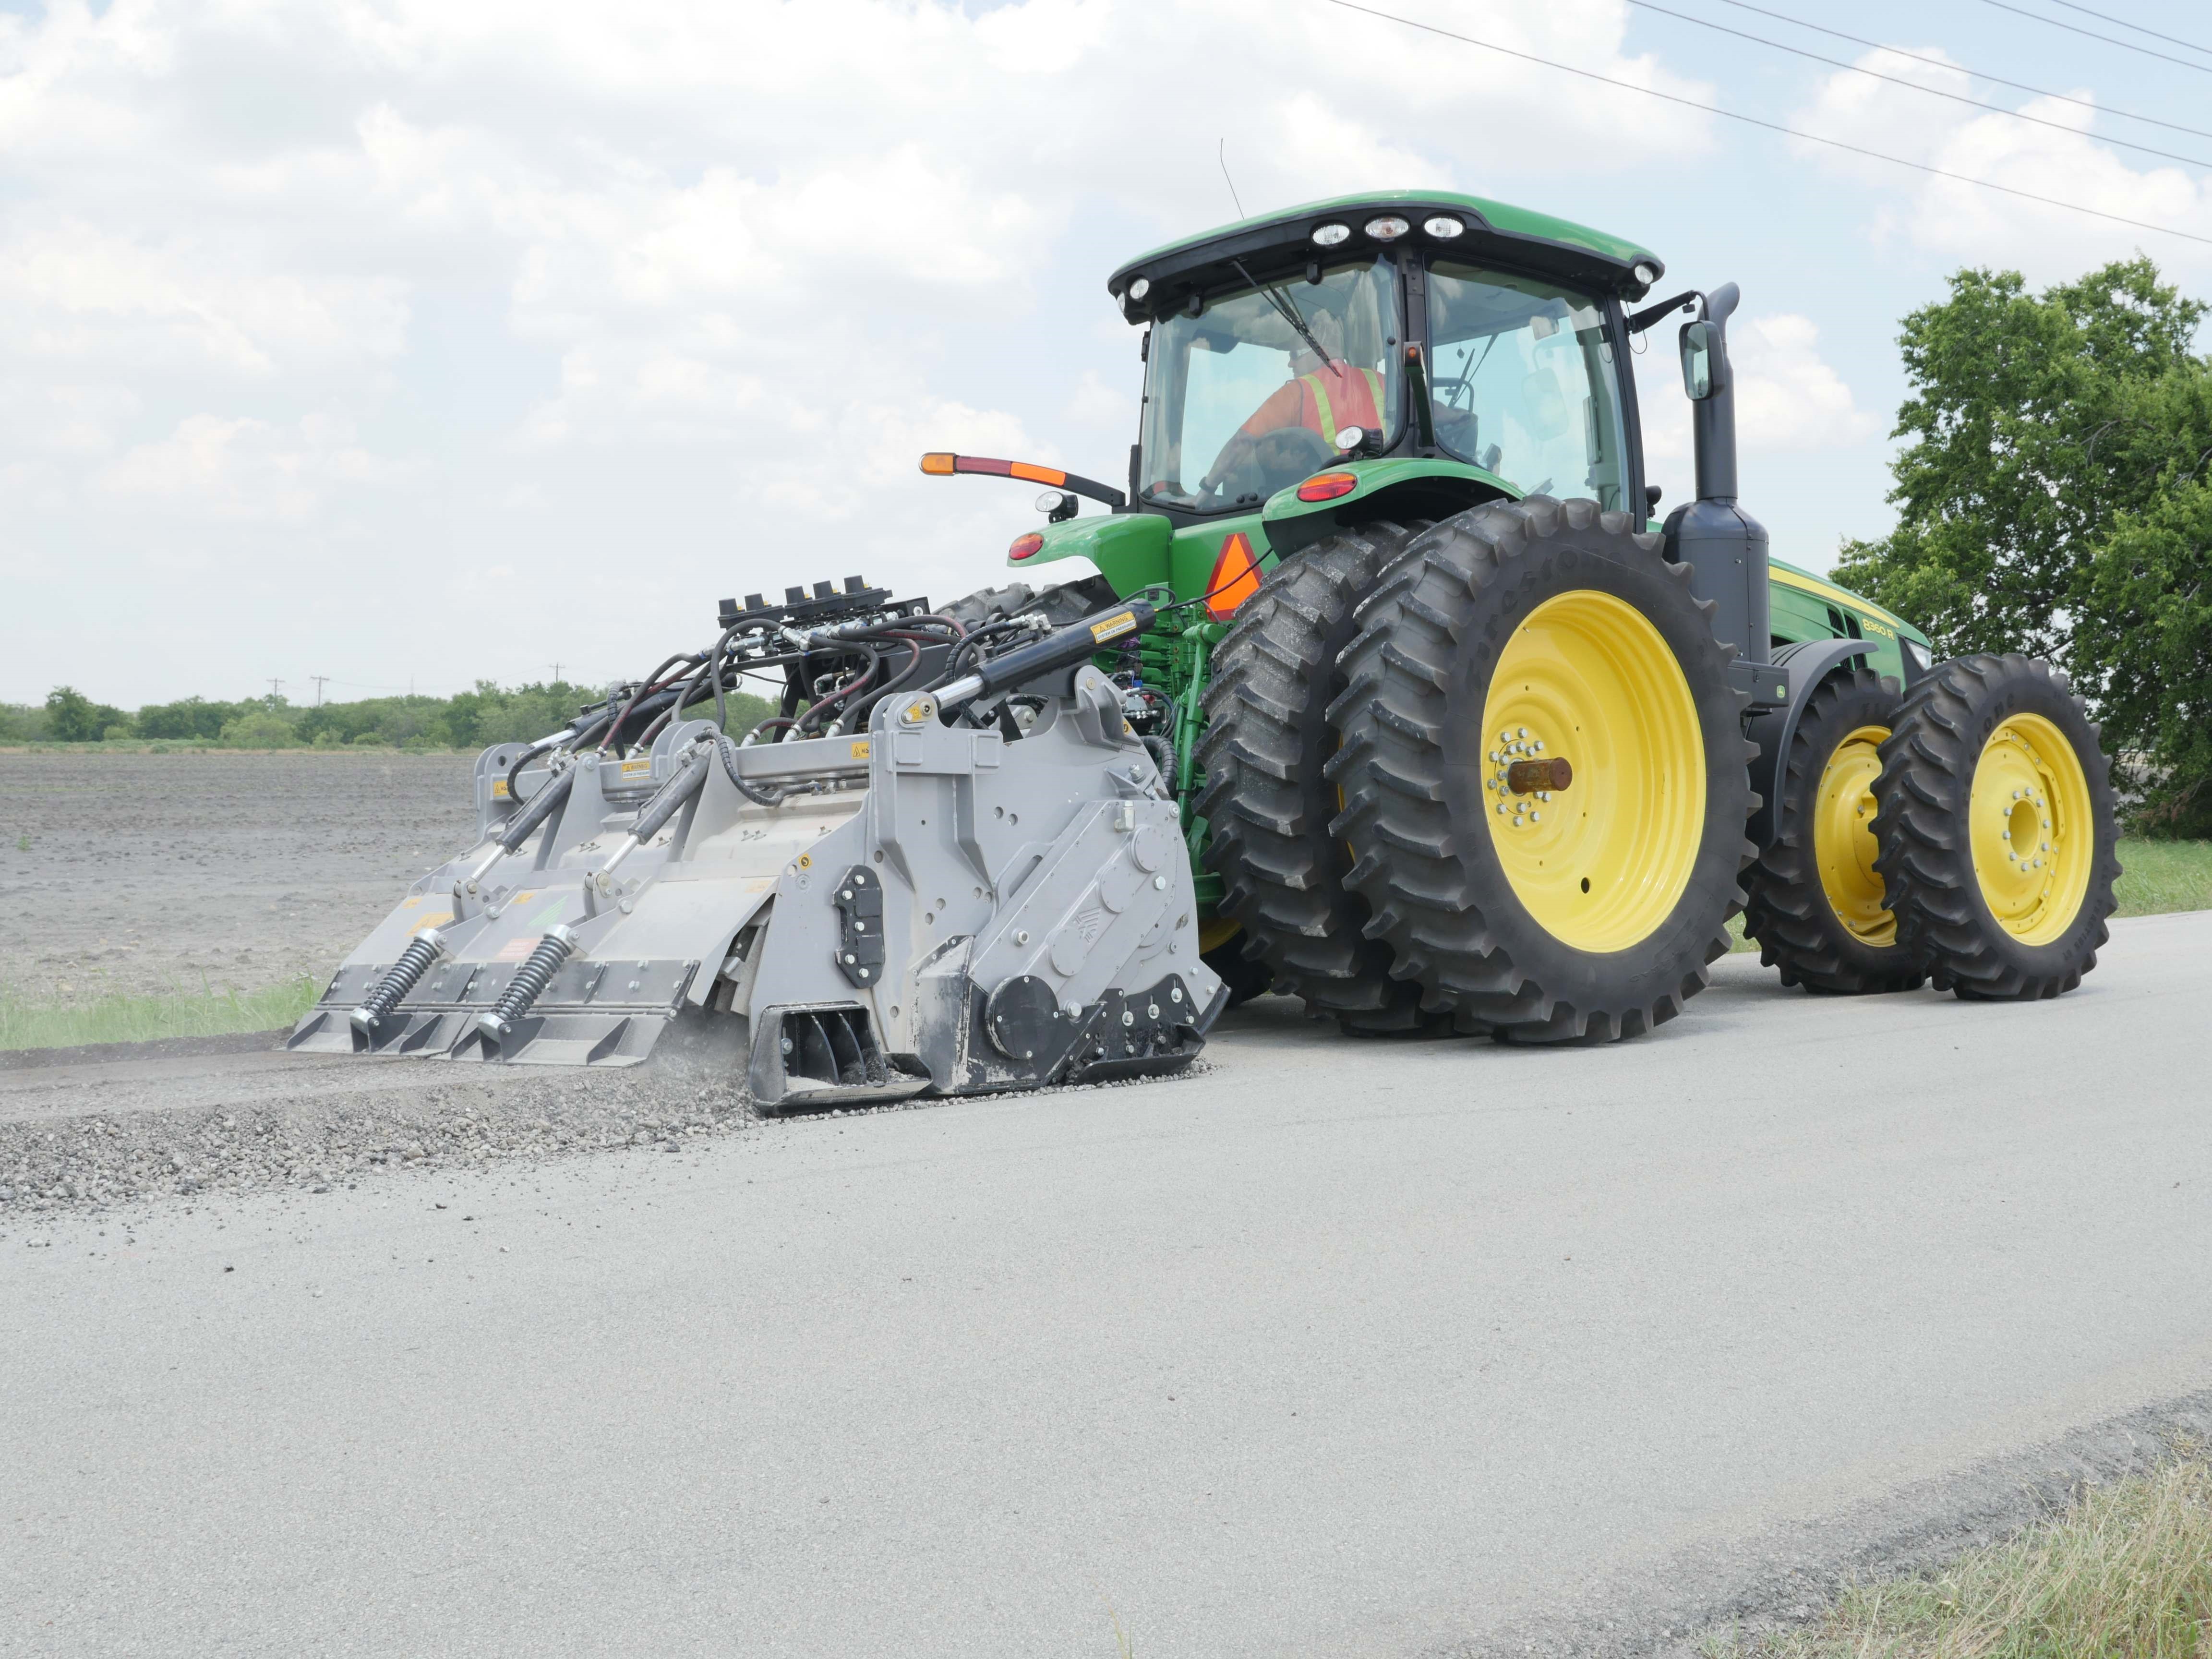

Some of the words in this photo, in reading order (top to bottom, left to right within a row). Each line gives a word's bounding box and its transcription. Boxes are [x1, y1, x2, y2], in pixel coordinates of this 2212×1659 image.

[1106, 616, 1128, 628] WARNING
[1863, 618, 1886, 636] 8360
[1887, 628, 1895, 640] R
